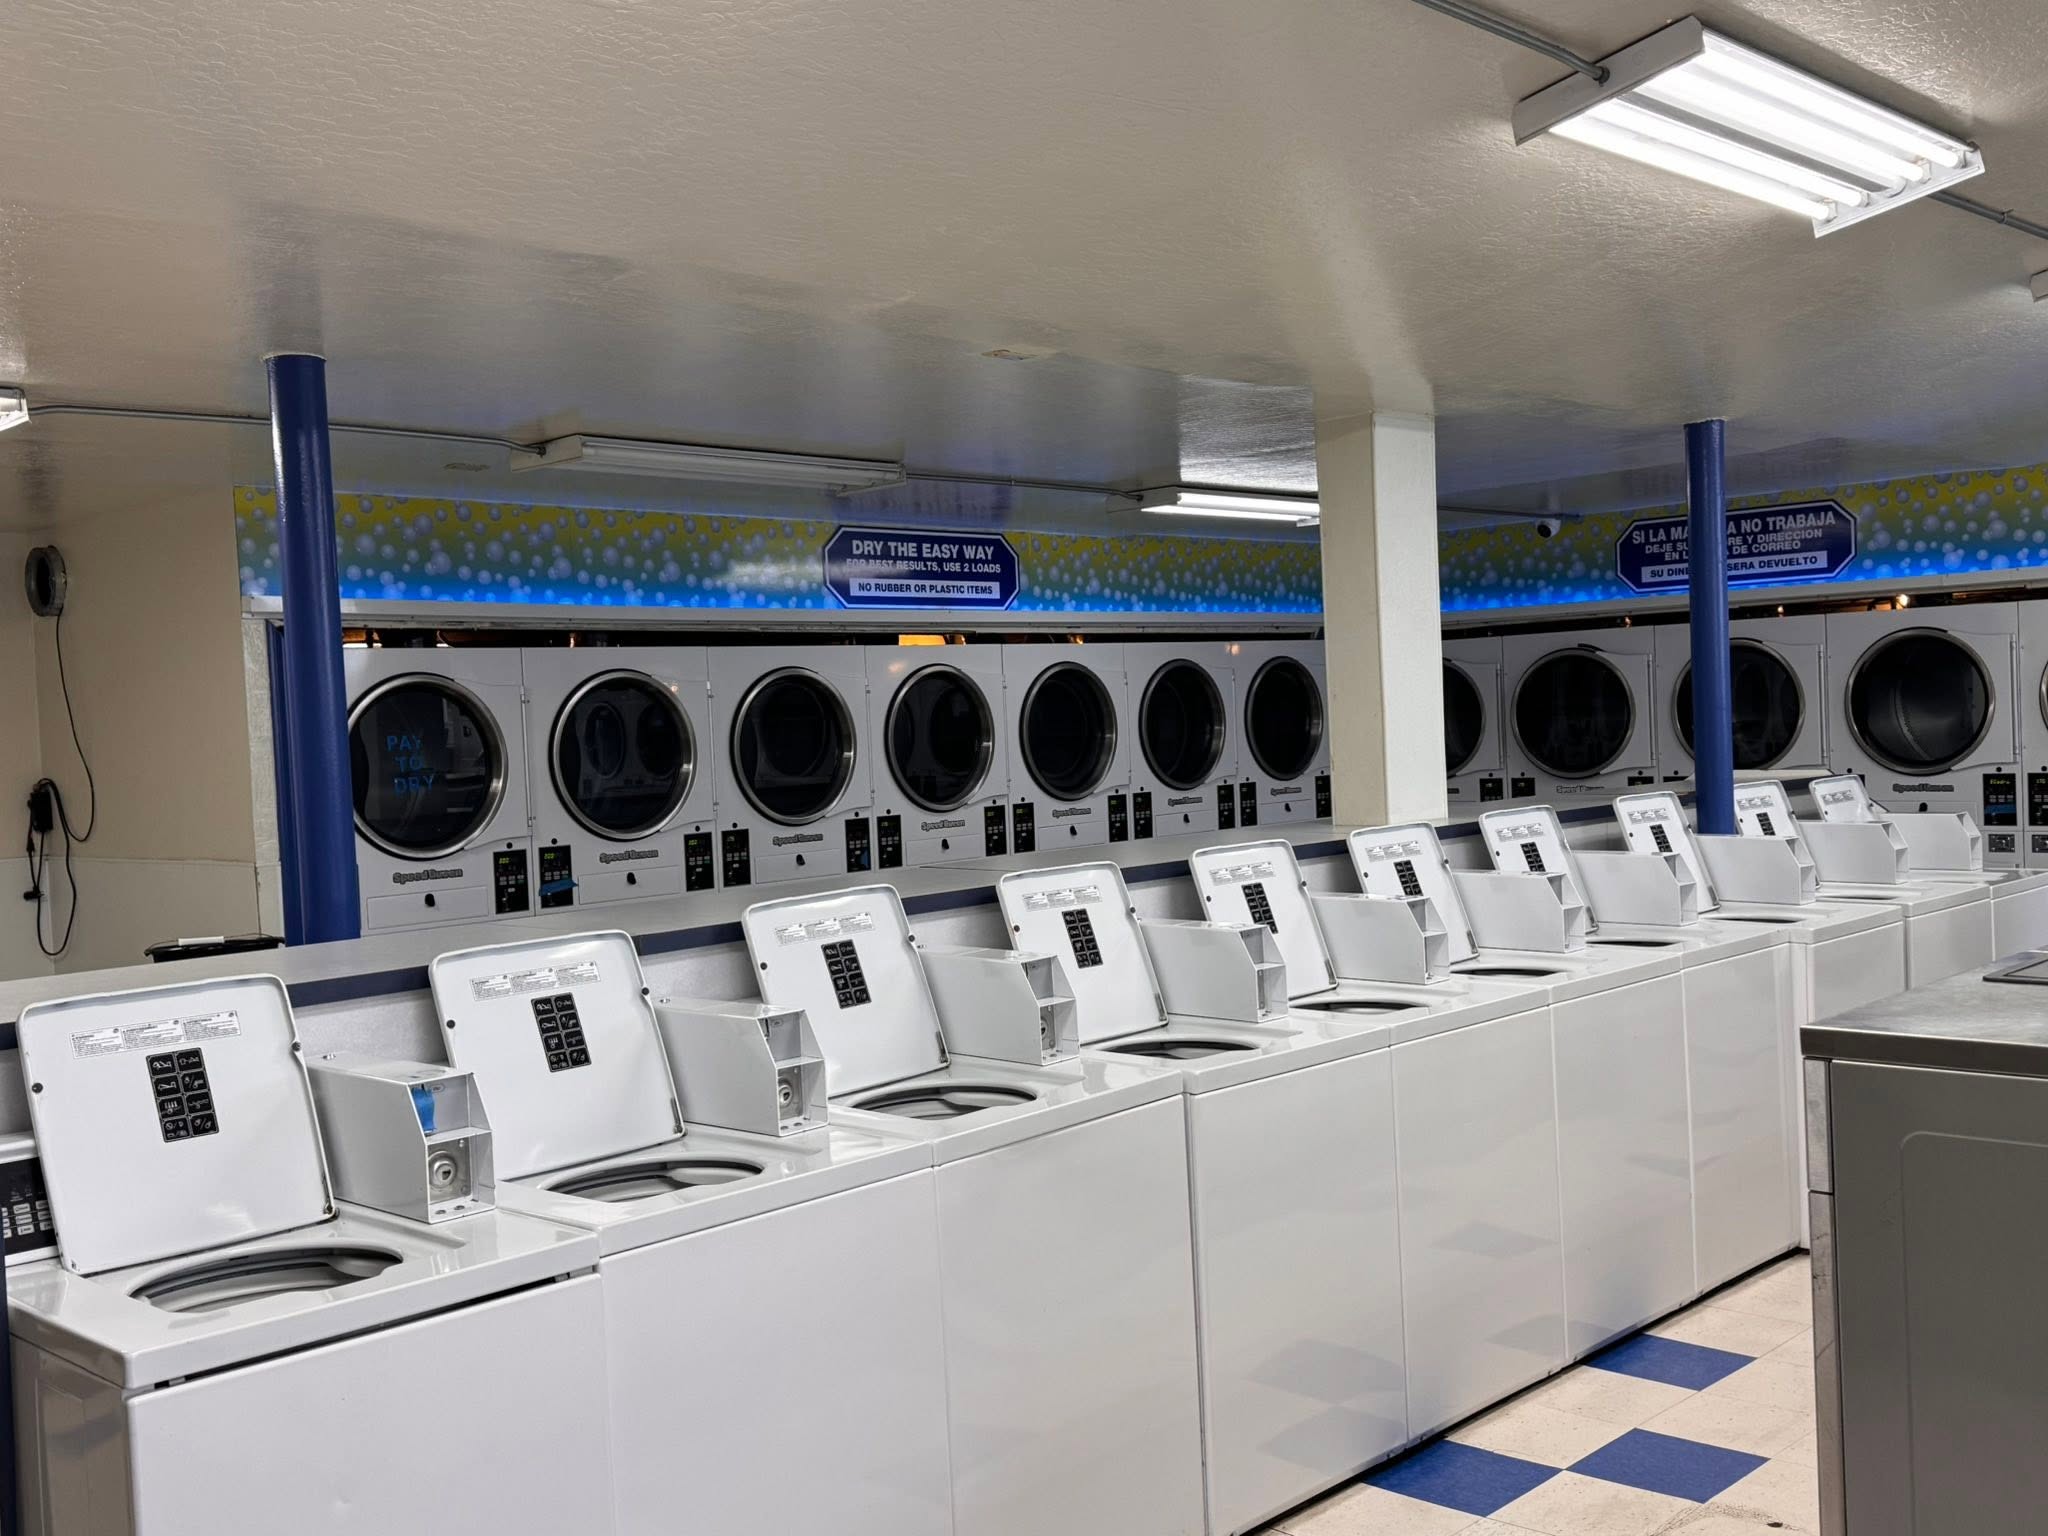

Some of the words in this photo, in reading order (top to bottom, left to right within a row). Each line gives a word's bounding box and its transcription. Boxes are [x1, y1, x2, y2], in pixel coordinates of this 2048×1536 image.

[1632, 529, 1645, 544] SI
[1649, 528, 1667, 542] LA
[1740, 518, 1762, 534] NO
[1766, 511, 1836, 531] TRABAJA
[852, 540, 883, 555] DRY
[888, 541, 918, 557] THE
[922, 543, 959, 559] EASY
[962, 544, 994, 560] WAY
[1645, 543, 1673, 554] DEJE
[1746, 534, 1754, 544] Y
[1756, 528, 1823, 543] DIRECCION
[1664, 551, 1679, 561] EN
[1732, 545, 1748, 555] DE
[1751, 540, 1801, 553] CORREO
[846, 558, 866, 569] FOR
[868, 559, 894, 569] BEST
[896, 560, 941, 573] RESULTS,
[943, 561, 961, 572] USE
[963, 562, 970, 573] 2
[971, 562, 1001, 573] LOADS
[1650, 569, 1664, 578] SU
[1758, 556, 1818, 569] DEVUELTO
[858, 582, 872, 592] NO
[874, 582, 912, 593] RUBBER
[914, 583, 927, 593] OR
[929, 584, 965, 594] PLASTIC
[967, 585, 993, 595] ITEMS
[386, 735, 422, 752] PAY
